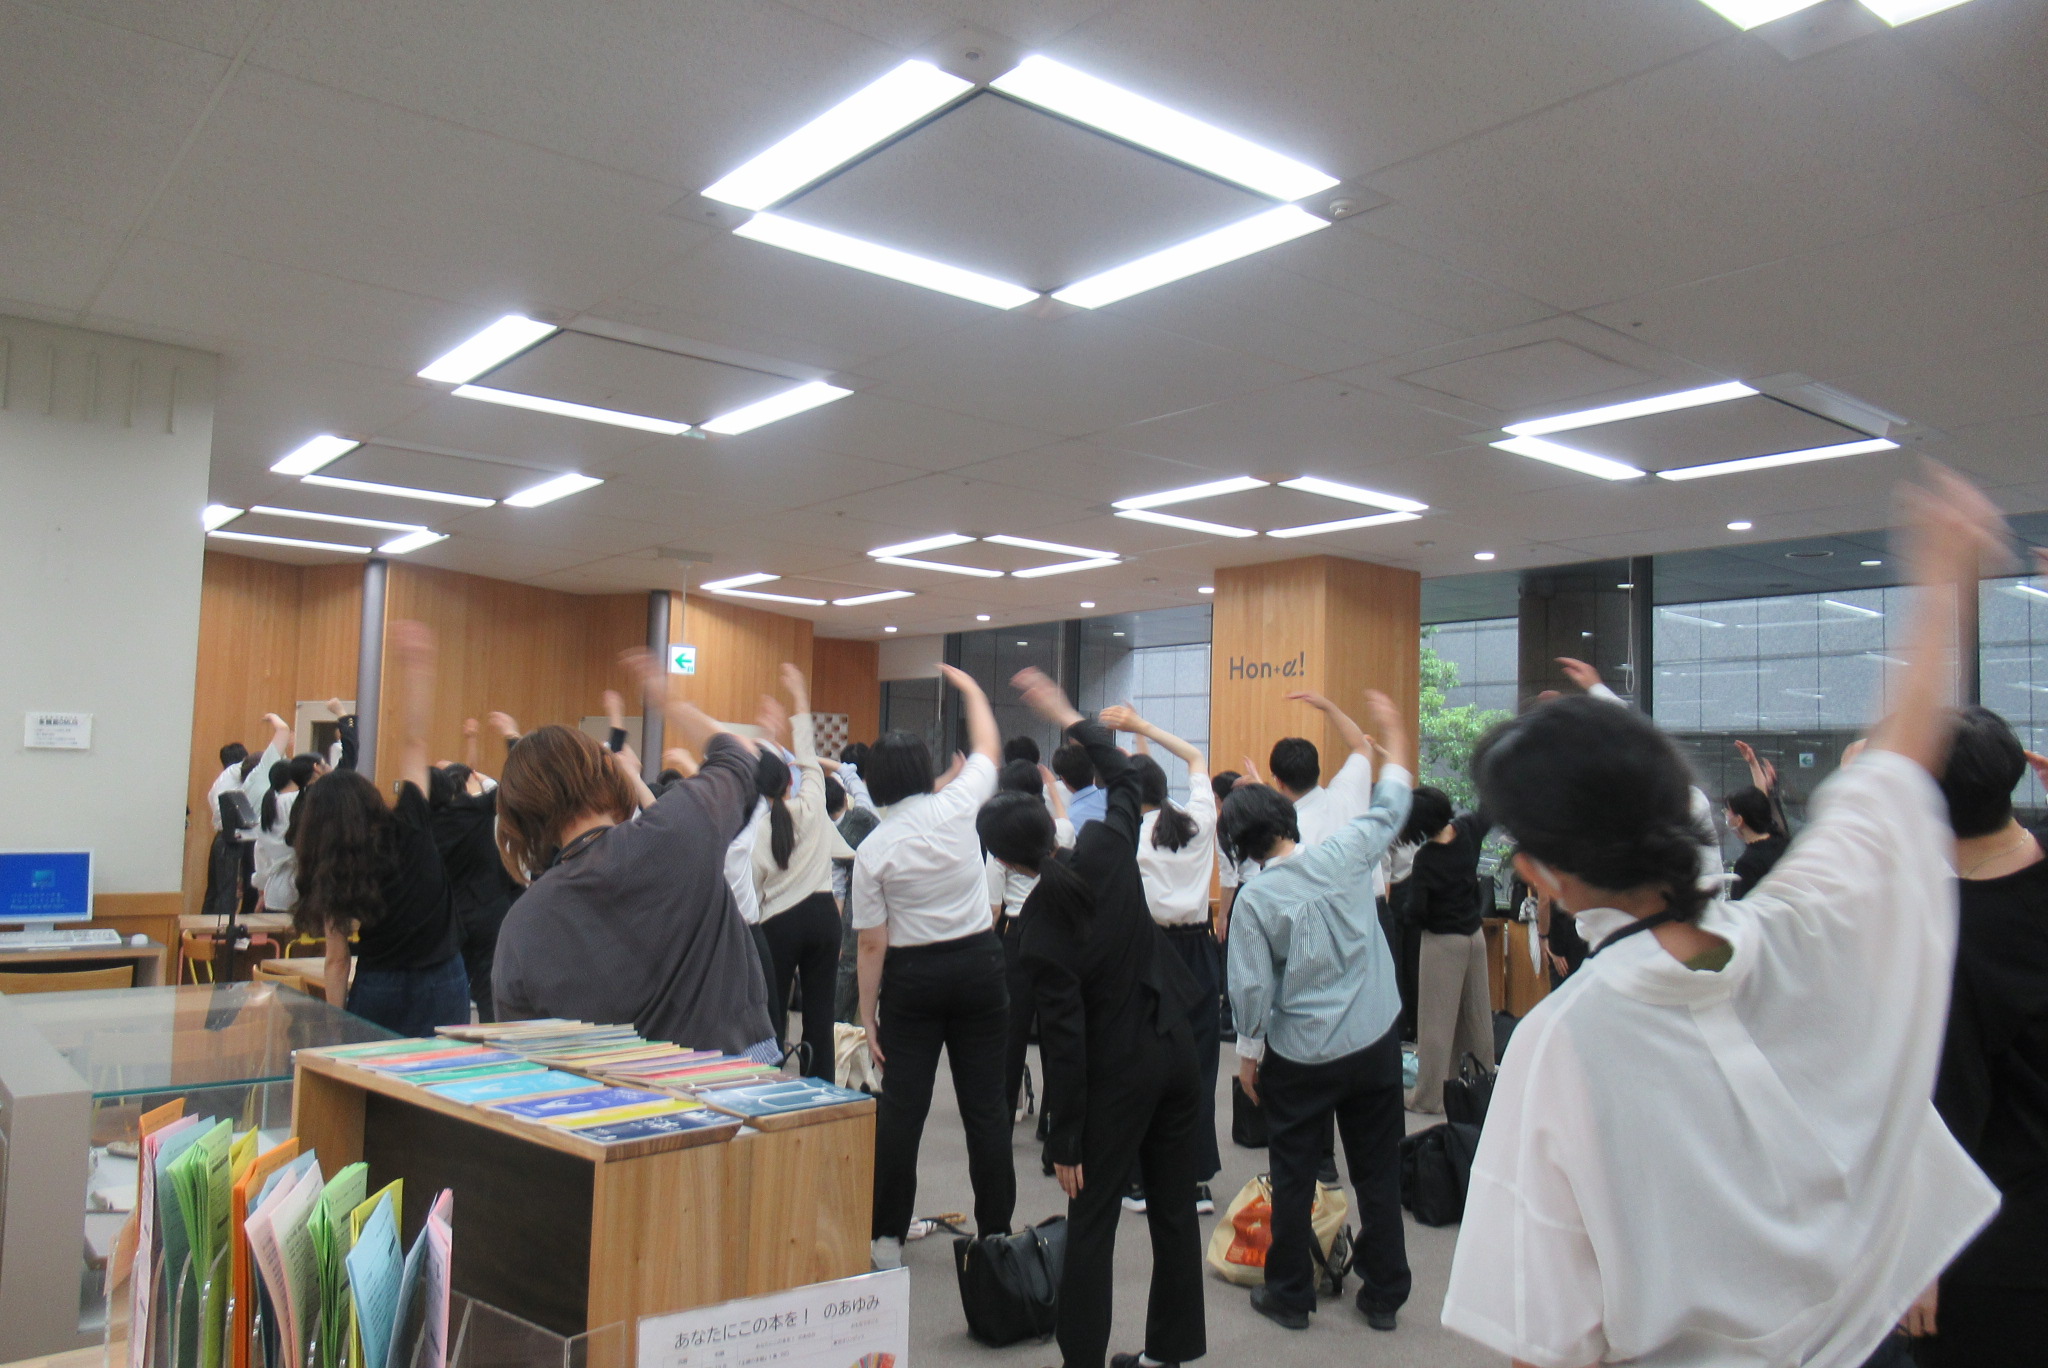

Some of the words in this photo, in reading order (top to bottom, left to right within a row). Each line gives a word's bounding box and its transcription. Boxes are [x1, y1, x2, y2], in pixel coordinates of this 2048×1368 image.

[674, 1307, 809, 1350] あなたにこの本を！
[823, 1294, 880, 1319] のあゆみ
